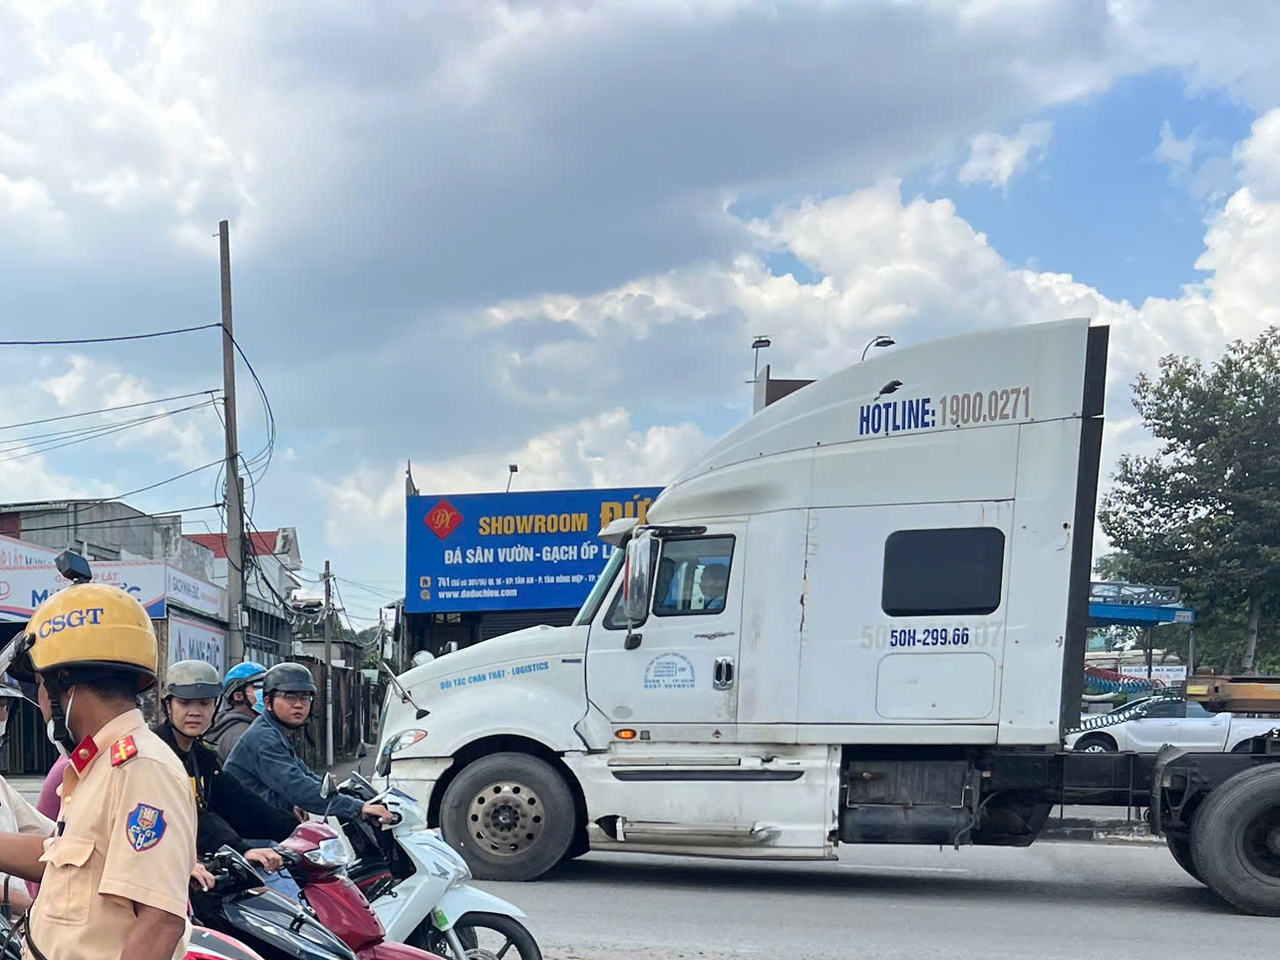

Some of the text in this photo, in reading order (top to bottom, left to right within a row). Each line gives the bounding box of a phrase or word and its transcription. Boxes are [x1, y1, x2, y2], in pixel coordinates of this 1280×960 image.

[859, 386, 1031, 435] HOTLINE: 1900.0271
[478, 494, 651, 537] SHOWROOM ĐỨ
[444, 546, 462, 564] ĐÁ
[465, 546, 494, 563] SÂN
[497, 544, 534, 562] VƯỜN
[542, 545, 578, 563] GẠCH
[580, 540, 599, 560] ỐP
[101, 572, 118, 581] LÁT
[39, 608, 104, 638] CSGT
[890, 627, 970, 647] 50H-299.66
[512, 661, 549, 676] LOGISTICS
